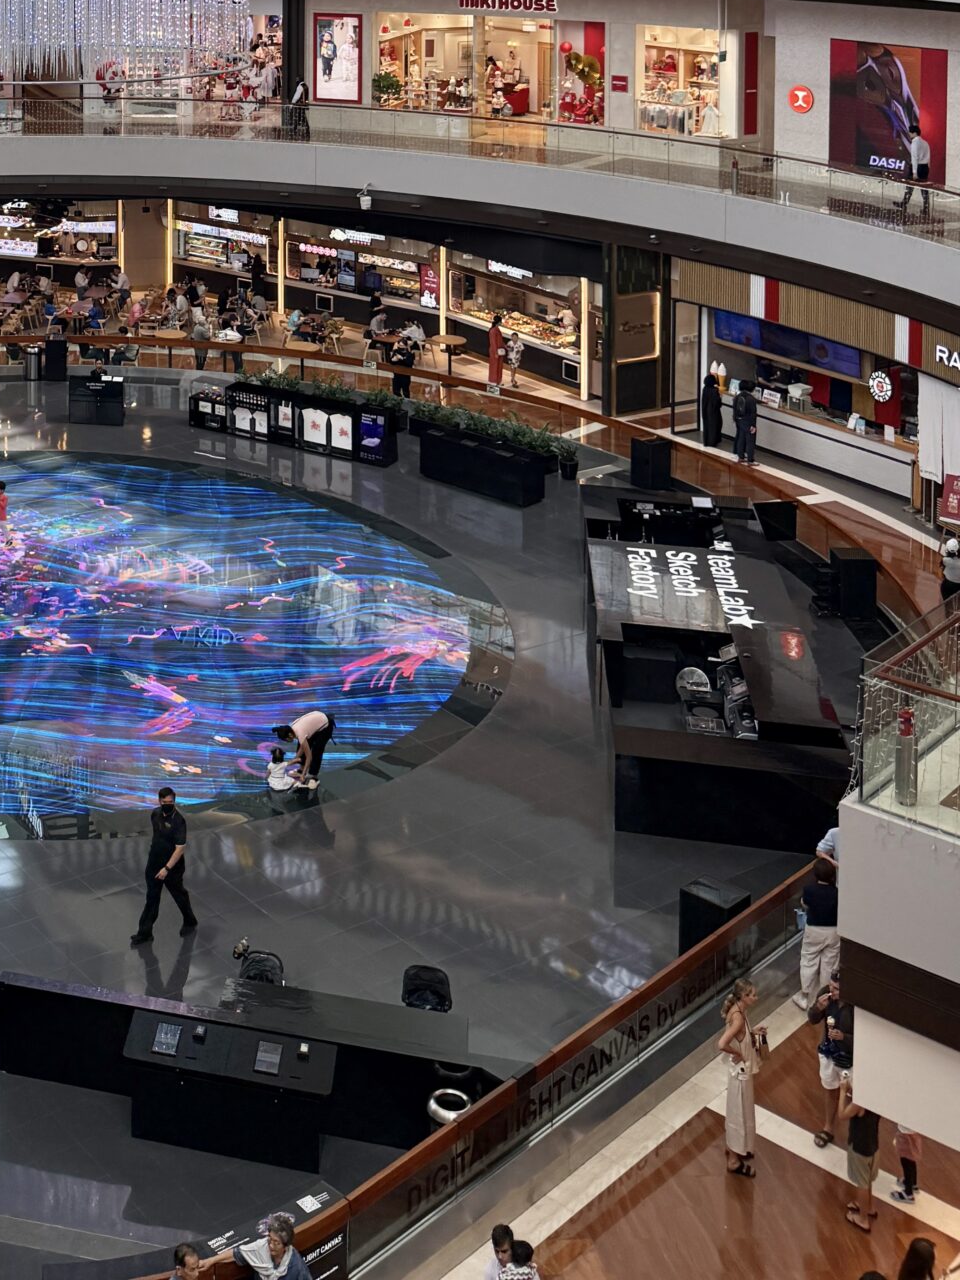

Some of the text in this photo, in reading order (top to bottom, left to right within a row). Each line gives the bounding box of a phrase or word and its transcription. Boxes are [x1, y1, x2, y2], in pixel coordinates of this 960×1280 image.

[869, 155, 906, 171] DASH
[626, 547, 660, 599] Factory
[665, 550, 706, 597] Sketch
